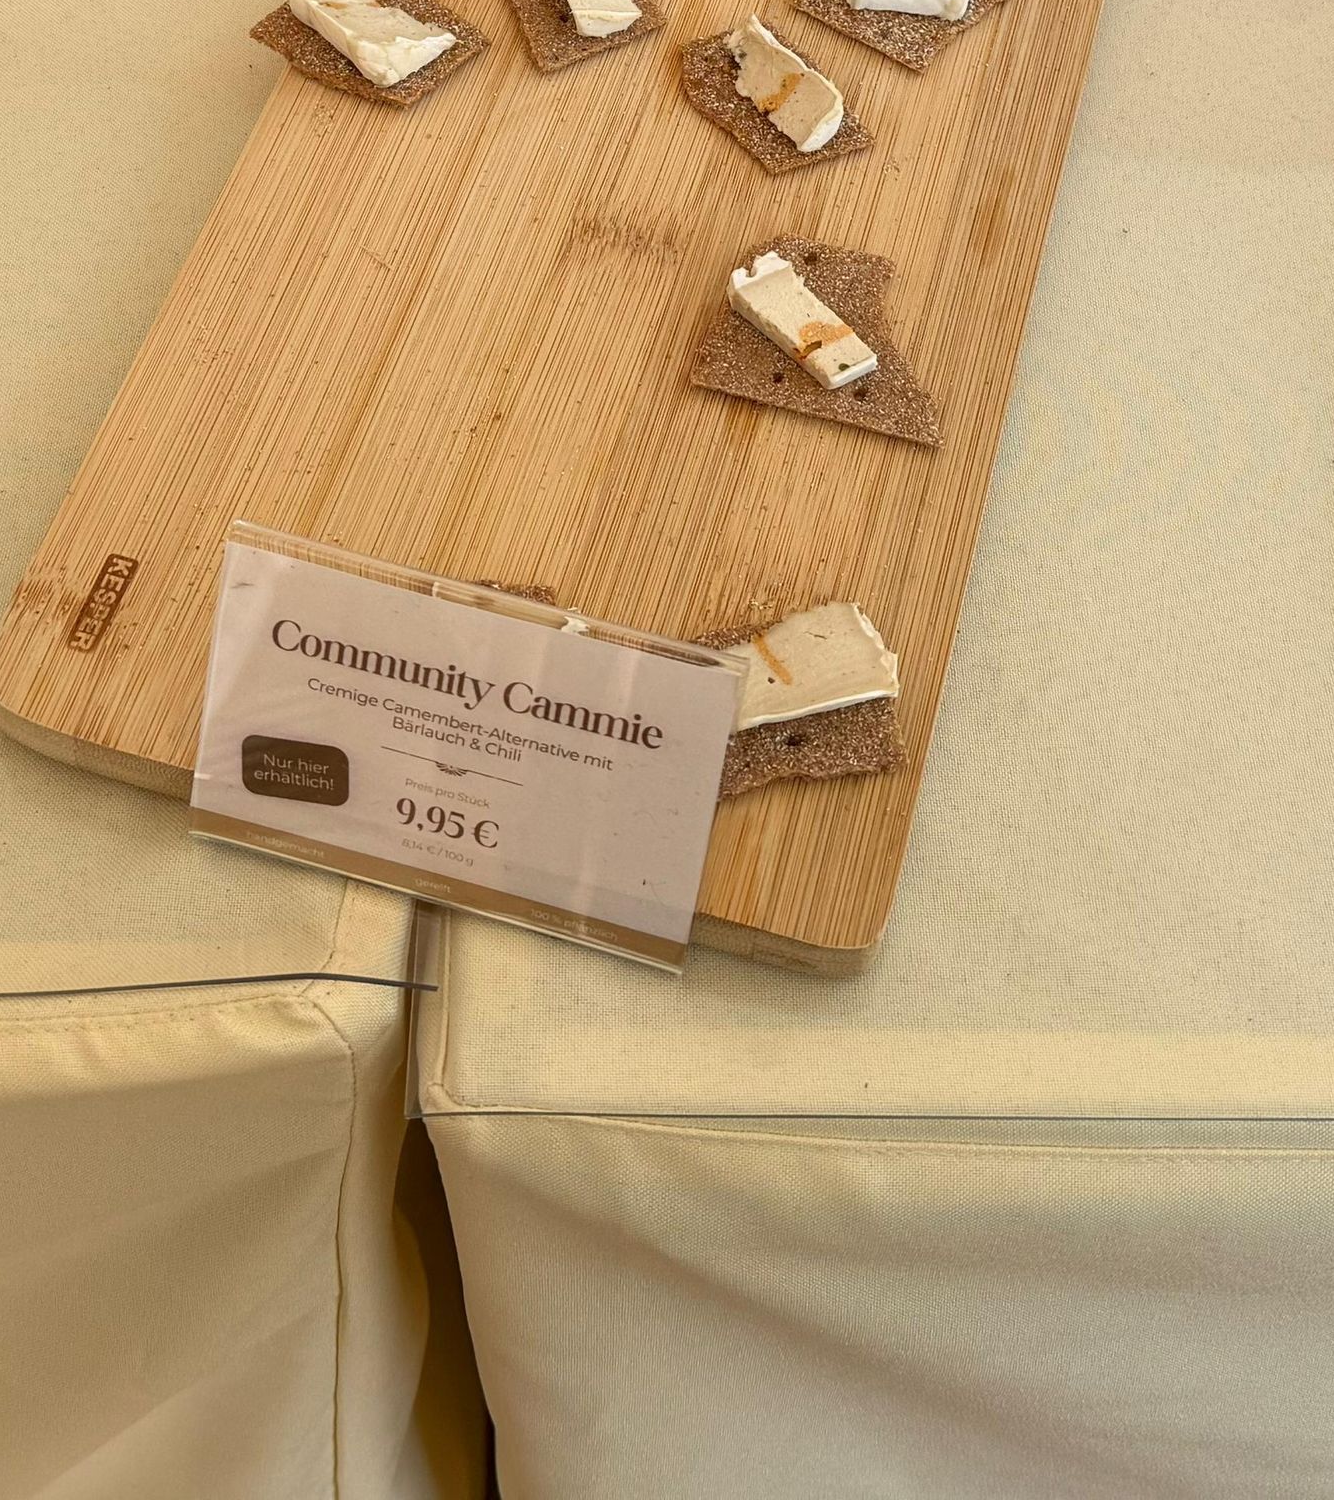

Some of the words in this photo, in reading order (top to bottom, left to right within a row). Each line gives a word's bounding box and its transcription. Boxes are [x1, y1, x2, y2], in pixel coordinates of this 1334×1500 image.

[70, 557, 133, 650] KESPER
[272, 619, 496, 710] Community
[503, 681, 664, 749] Cammie
[308, 678, 378, 707] Cremige
[383, 698, 580, 761] Camembert-Alternative
[584, 753, 613, 771] mit
[392, 716, 466, 746] Bärlauch
[469, 738, 481, 750] &
[485, 743, 522, 762] Chili
[254, 769, 334, 791] erhältlich!
[264, 753, 294, 769] Nur
[299, 758, 330, 775] hier
[405, 778, 433, 793] Preis
[435, 787, 455, 799] pro
